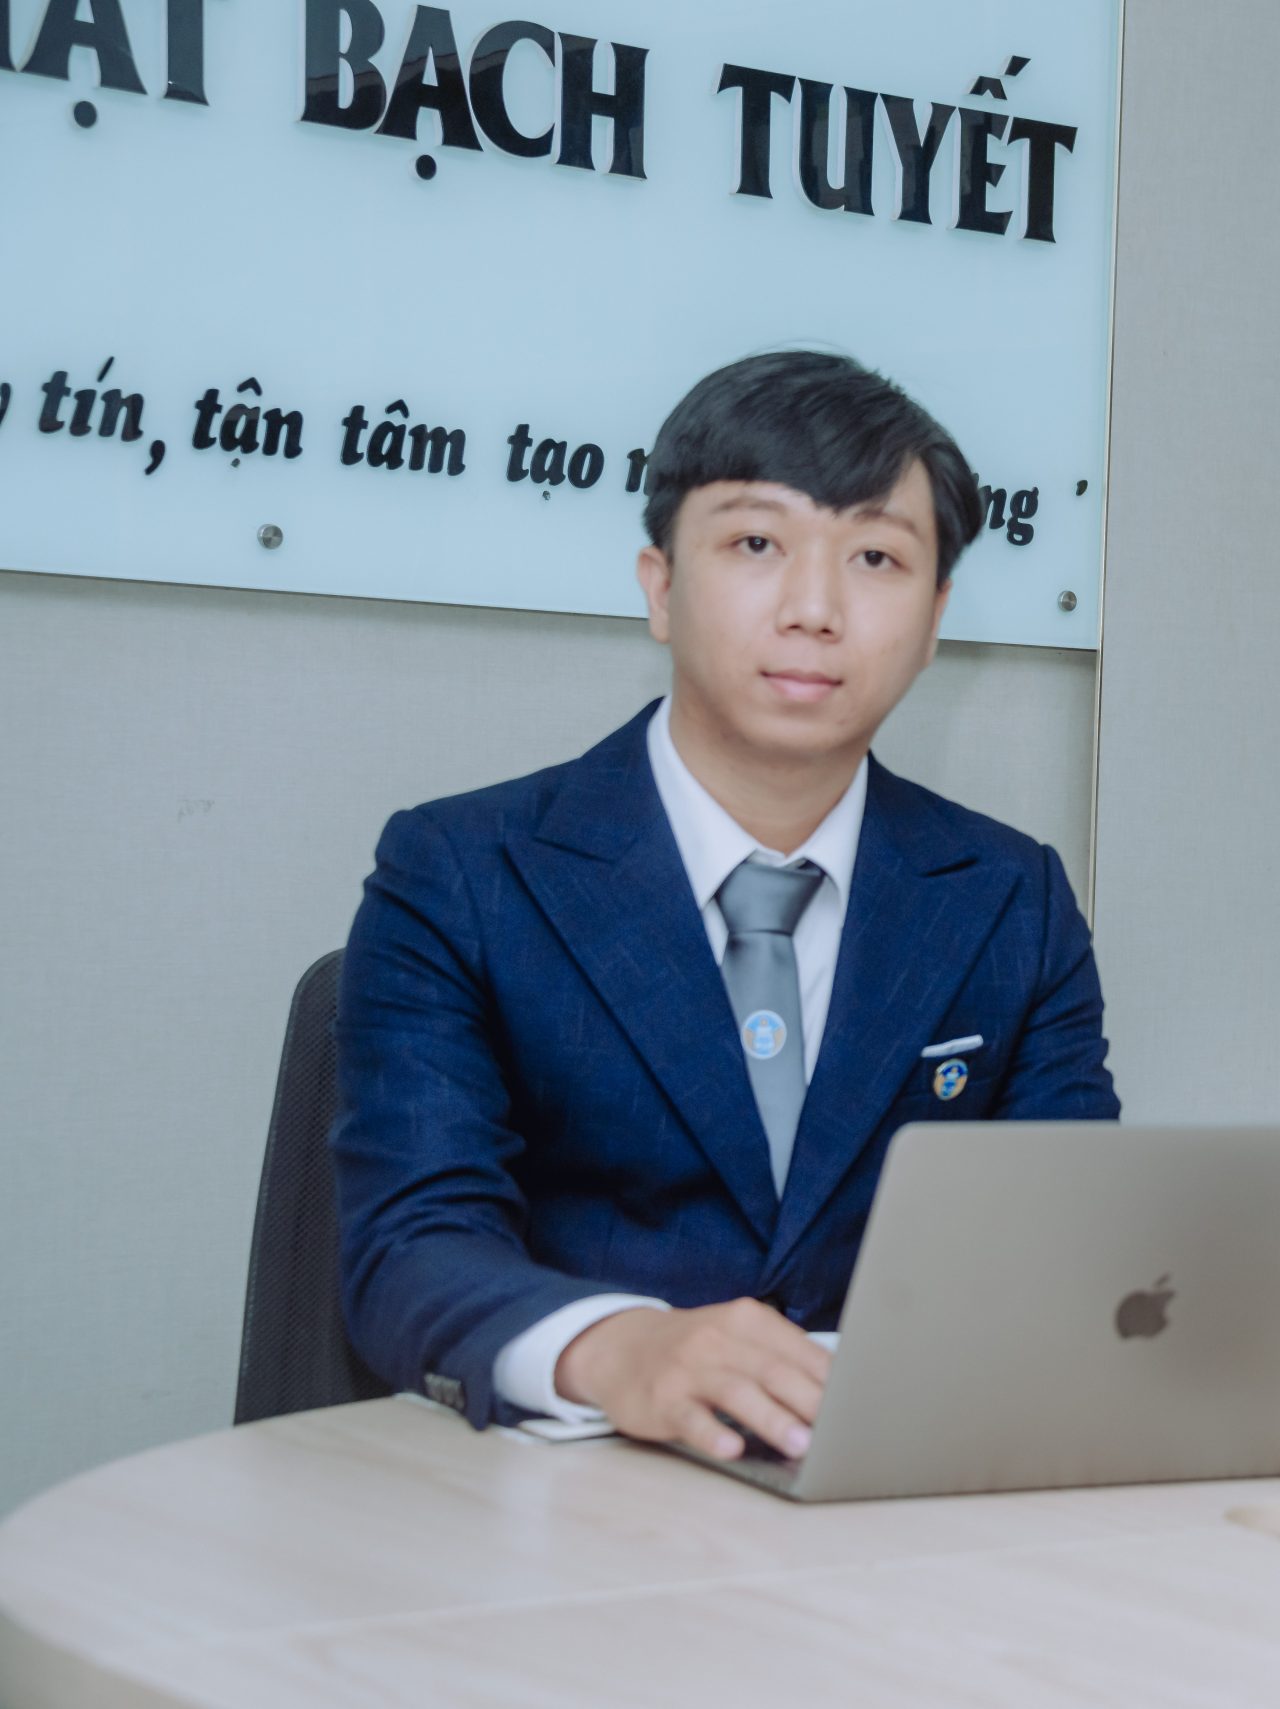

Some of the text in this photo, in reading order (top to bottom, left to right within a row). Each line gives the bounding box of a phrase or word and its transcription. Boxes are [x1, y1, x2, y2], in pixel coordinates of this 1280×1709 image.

[299, 0, 651, 181] BẠCH
[713, 55, 1079, 245] TUYẾT
[38, 356, 166, 476] tín,
[191, 377, 303, 468] tận
[340, 399, 467, 477] tâm
[506, 423, 605, 501] tạo
